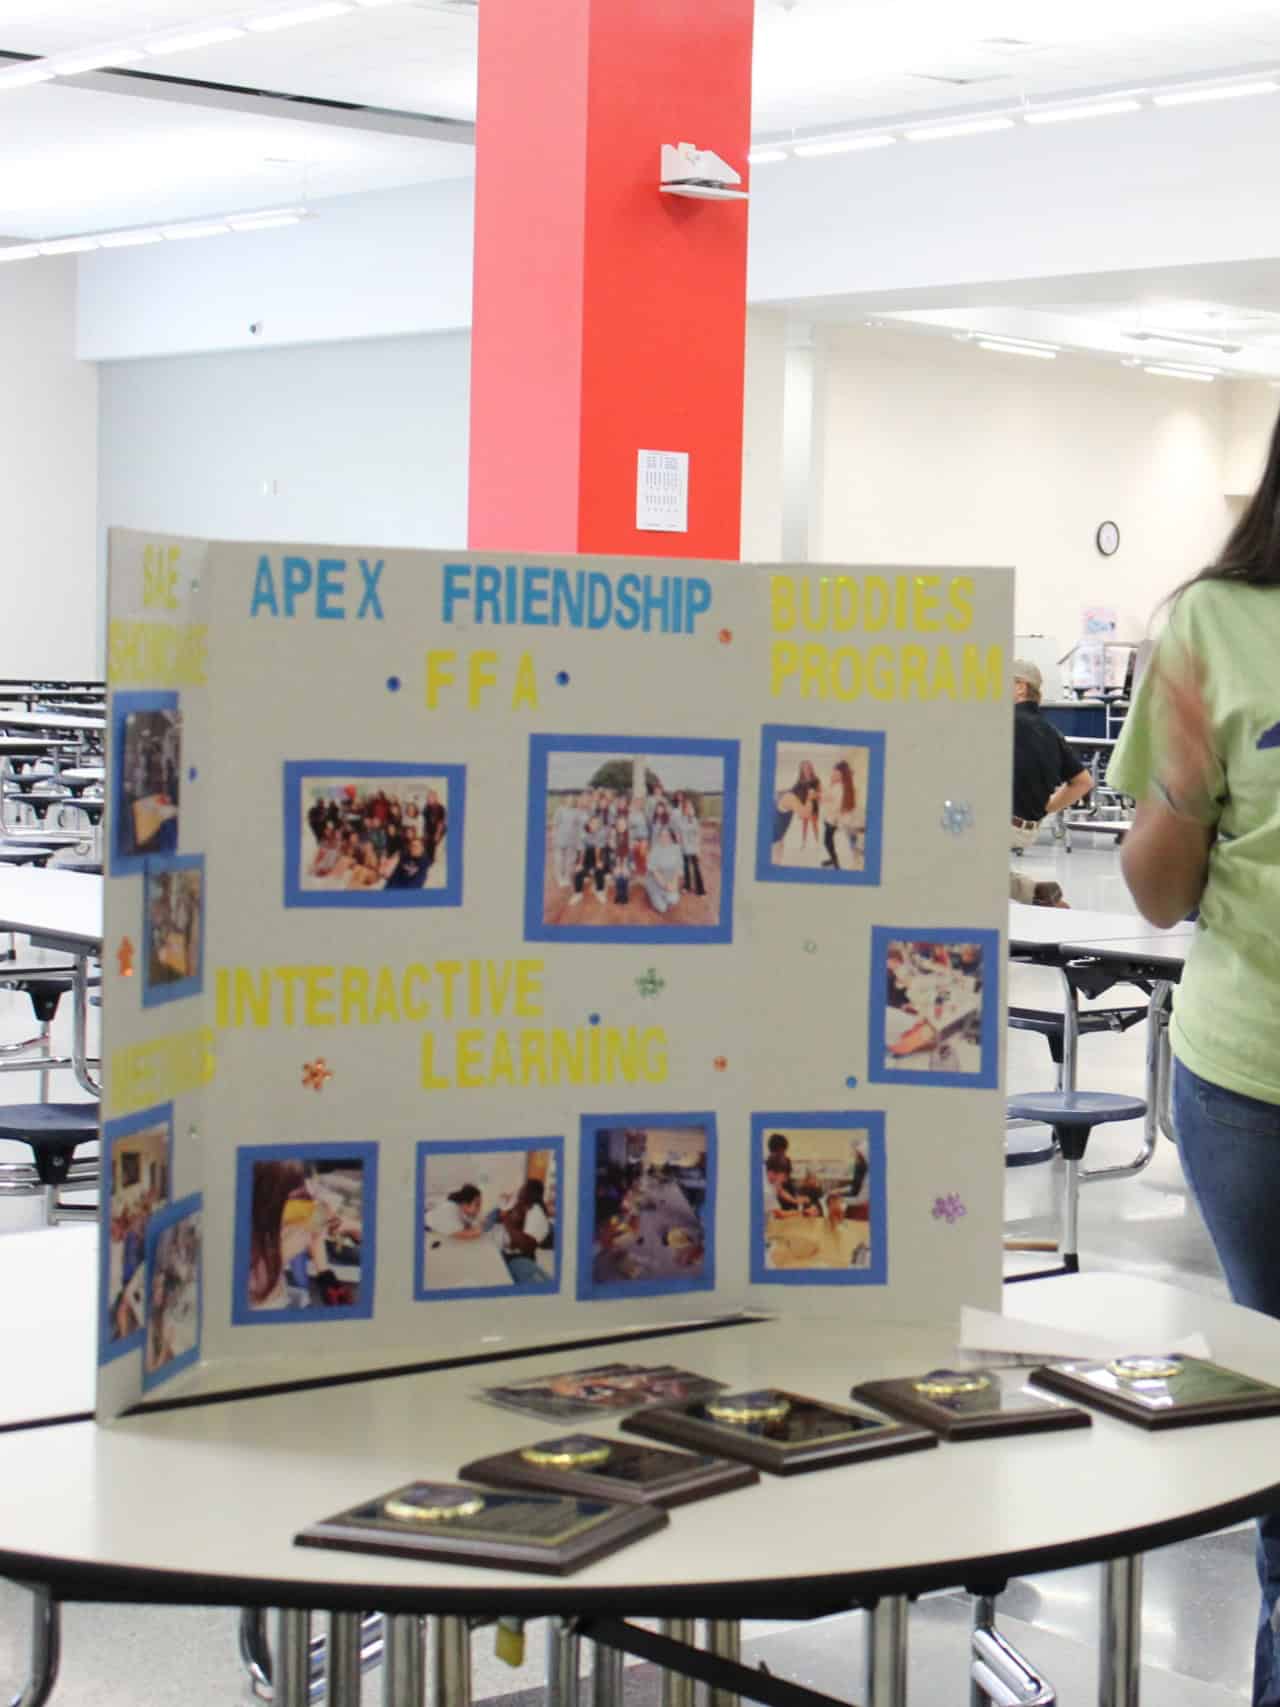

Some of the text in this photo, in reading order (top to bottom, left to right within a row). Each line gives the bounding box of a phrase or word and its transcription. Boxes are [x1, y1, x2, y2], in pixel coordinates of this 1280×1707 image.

[250, 555, 712, 634] APEX FRIENDSHIP
[769, 574, 976, 633] BUDDIES
[424, 648, 540, 711] FFA
[768, 642, 1003, 702] PROGRAM
[214, 959, 546, 1029] INTERACTIVE
[419, 1025, 670, 1091] LEARNING
